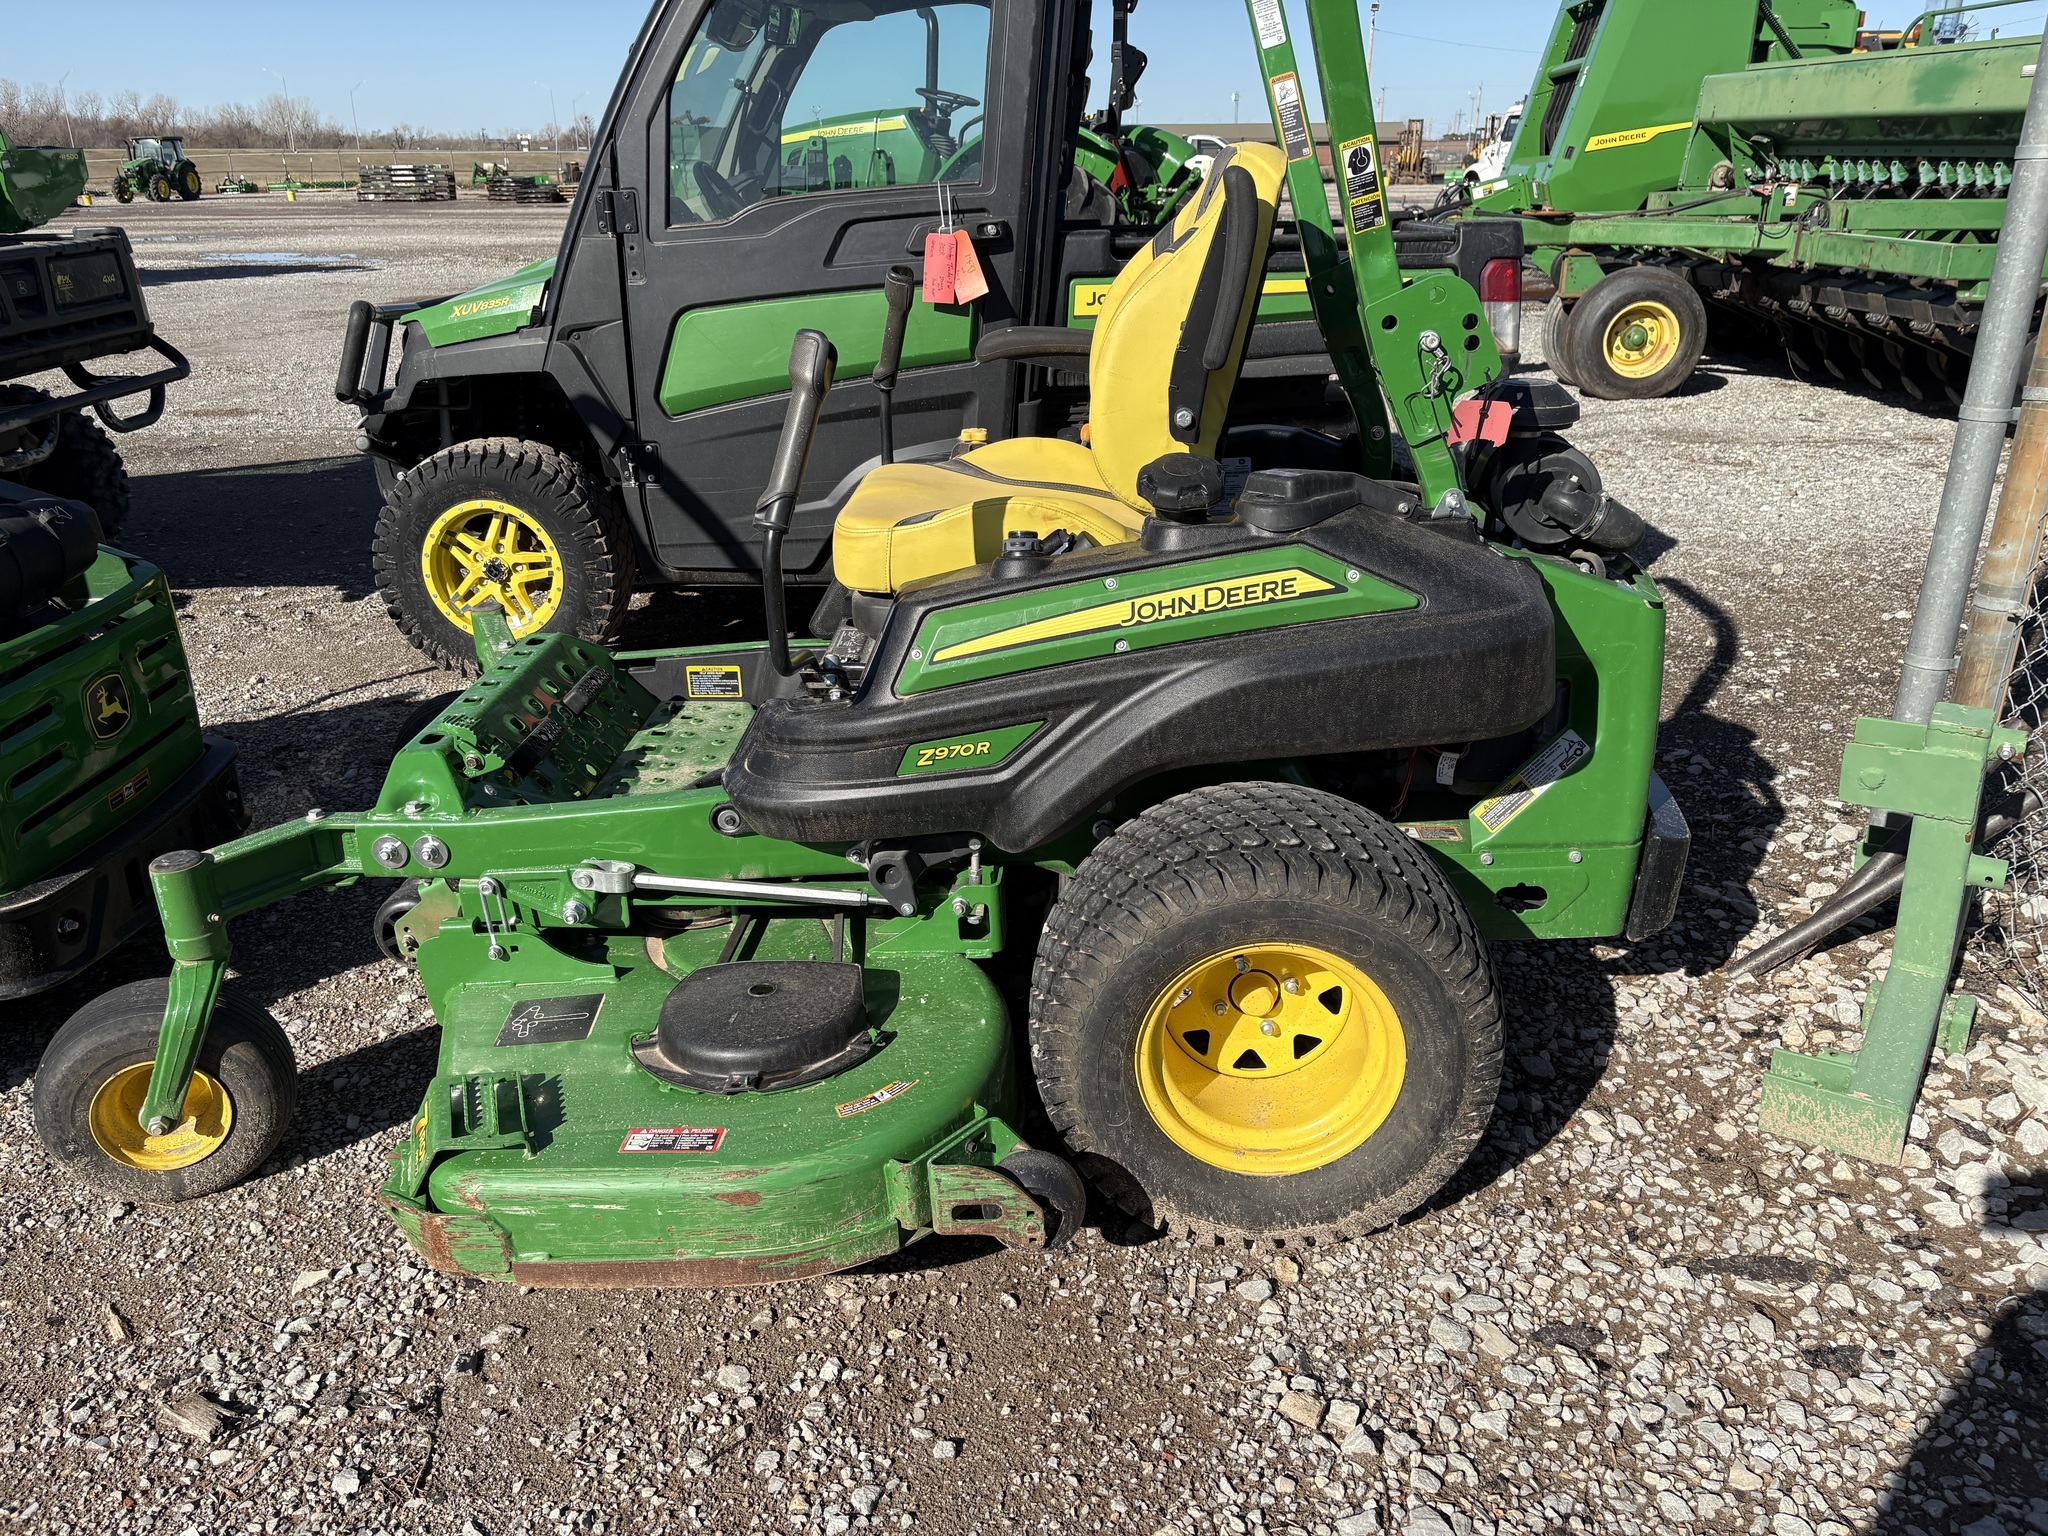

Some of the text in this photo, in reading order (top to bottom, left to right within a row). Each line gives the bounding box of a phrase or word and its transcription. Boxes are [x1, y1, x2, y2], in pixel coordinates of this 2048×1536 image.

[838, 126, 864, 135] DEERE
[1595, 132, 1646, 145] JOHN DEERE
[1346, 136, 1370, 147] CAUTION
[448, 296, 510, 320] XUV835R
[1121, 577, 1298, 624] JOHN DEERE
[916, 741, 991, 767] Z970R
